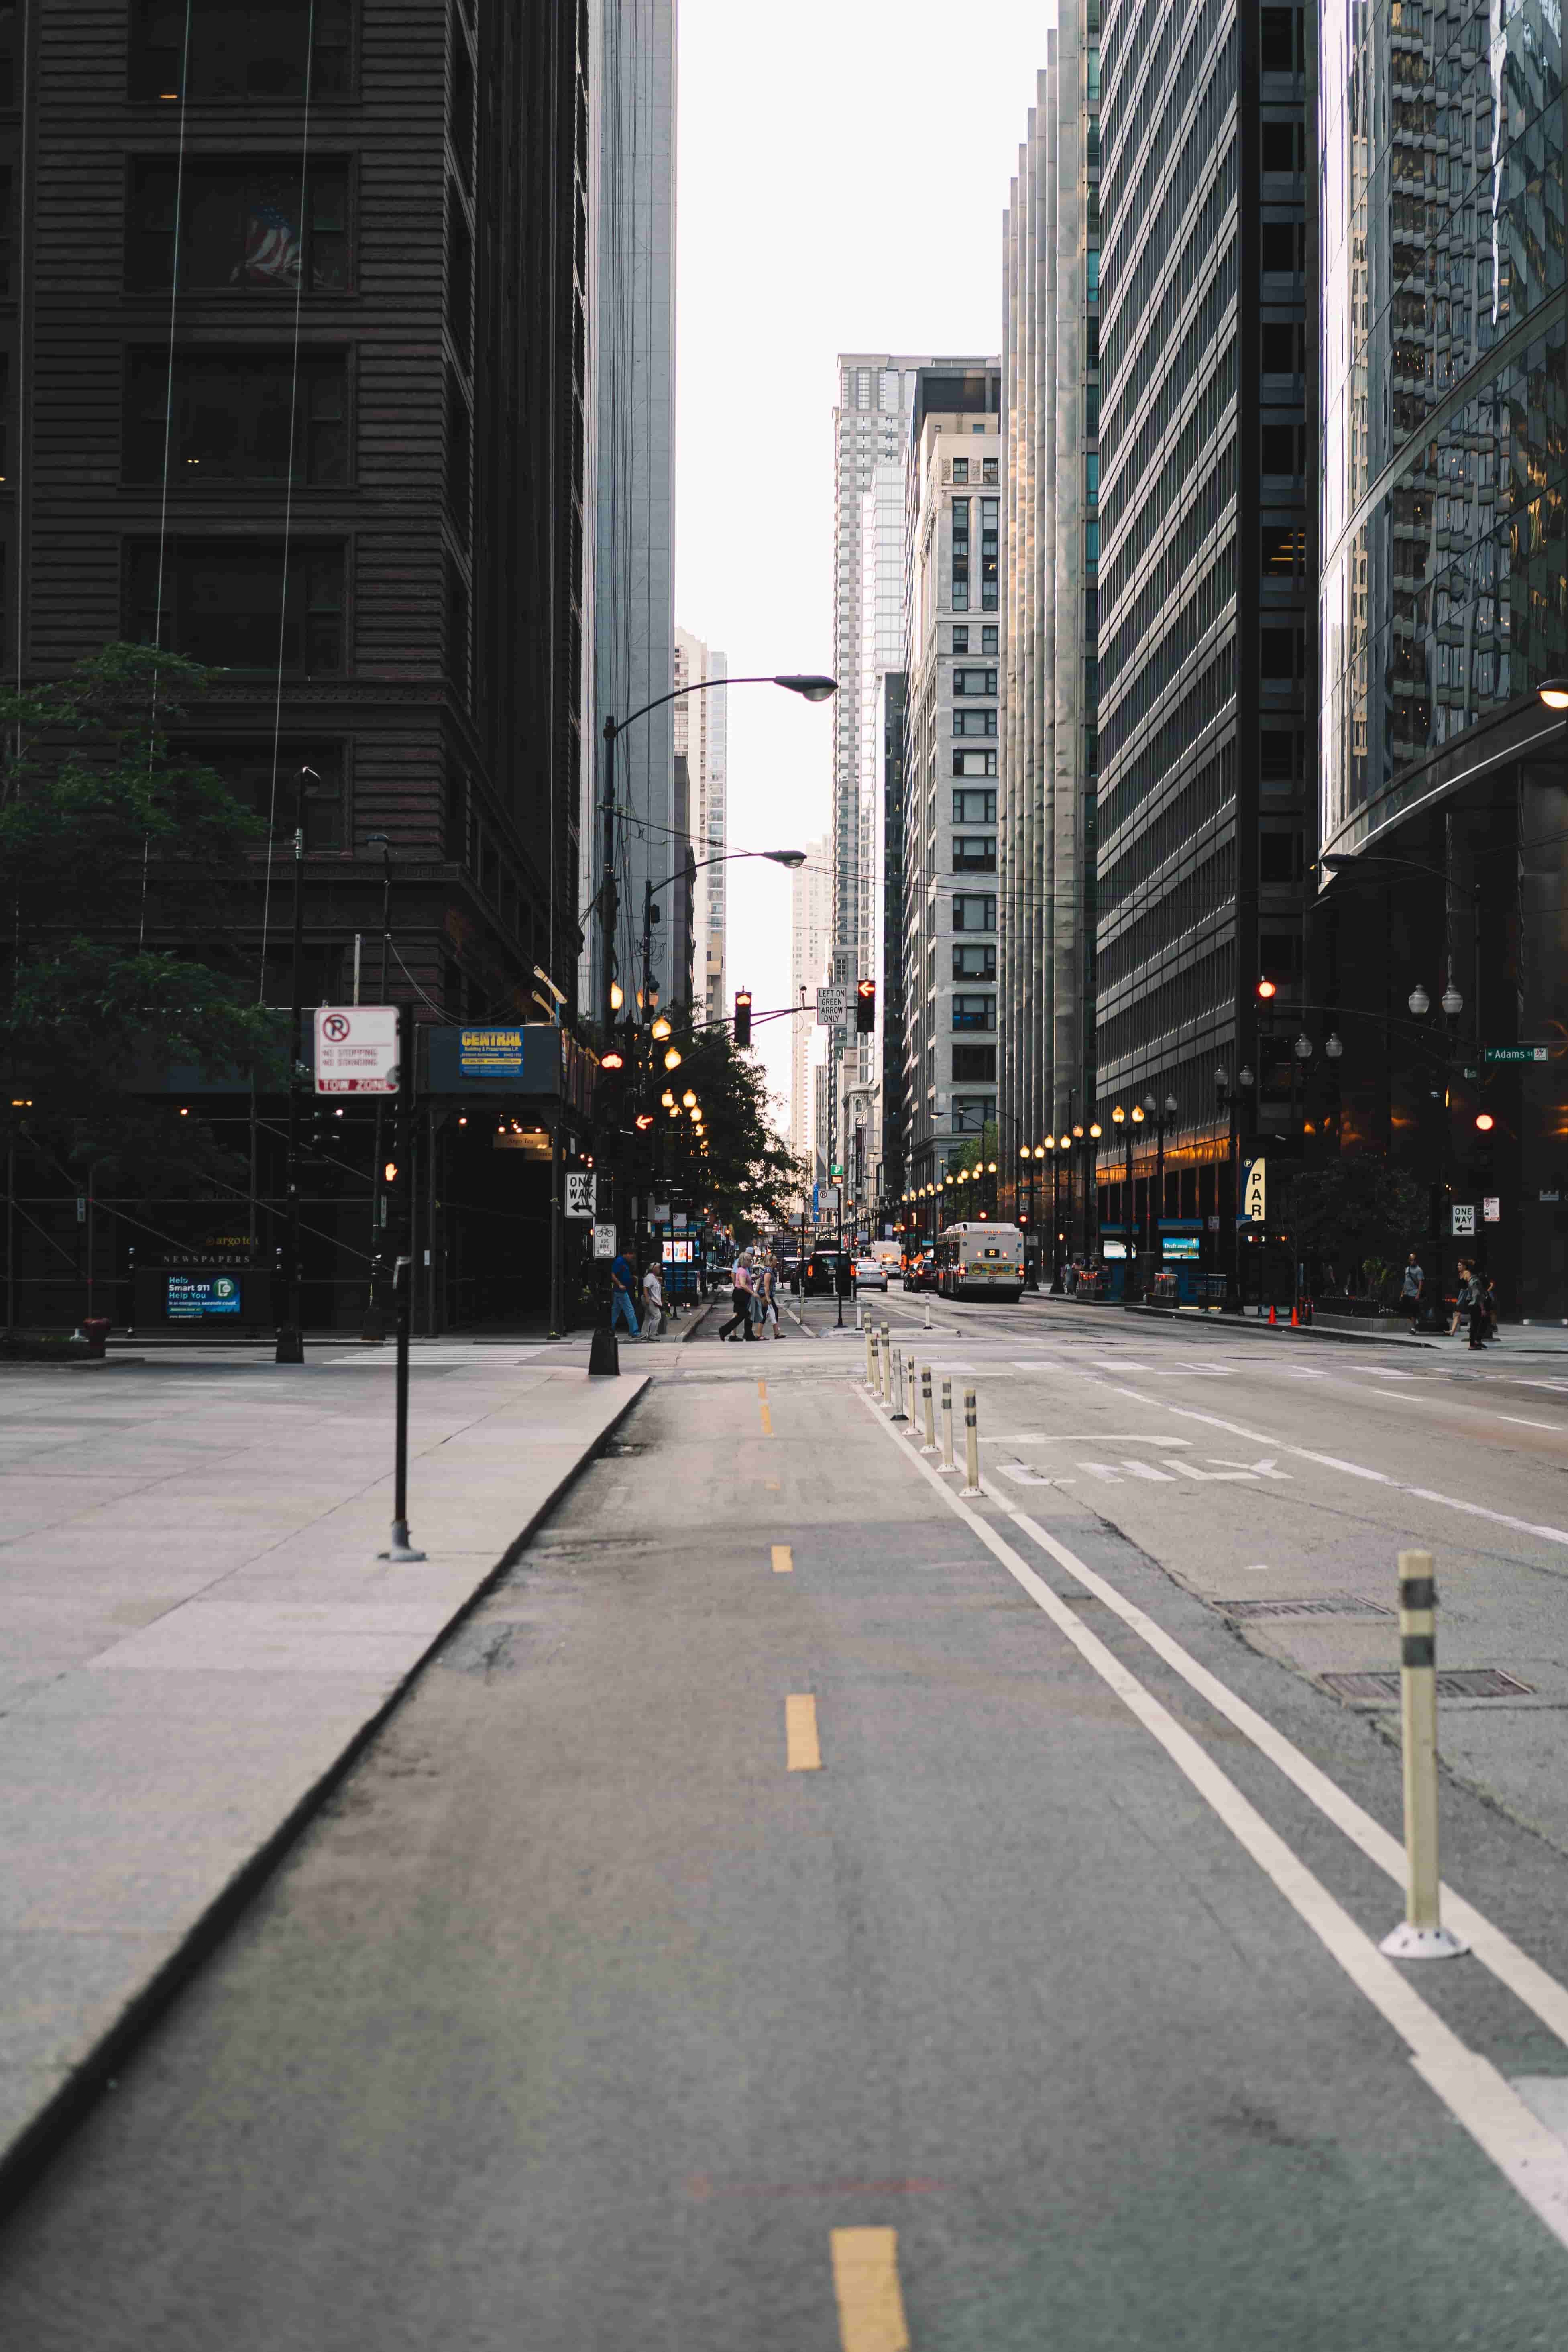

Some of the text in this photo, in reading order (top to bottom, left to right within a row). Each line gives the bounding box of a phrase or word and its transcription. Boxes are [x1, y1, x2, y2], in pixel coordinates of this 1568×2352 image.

[462, 1032, 522, 1047] CENTRAL
[1495, 1050, 1525, 1059] Adams
[321, 1080, 388, 1091] TOW ZONE
[570, 1177, 593, 1187] ONE
[569, 1189, 593, 1199] WAY
